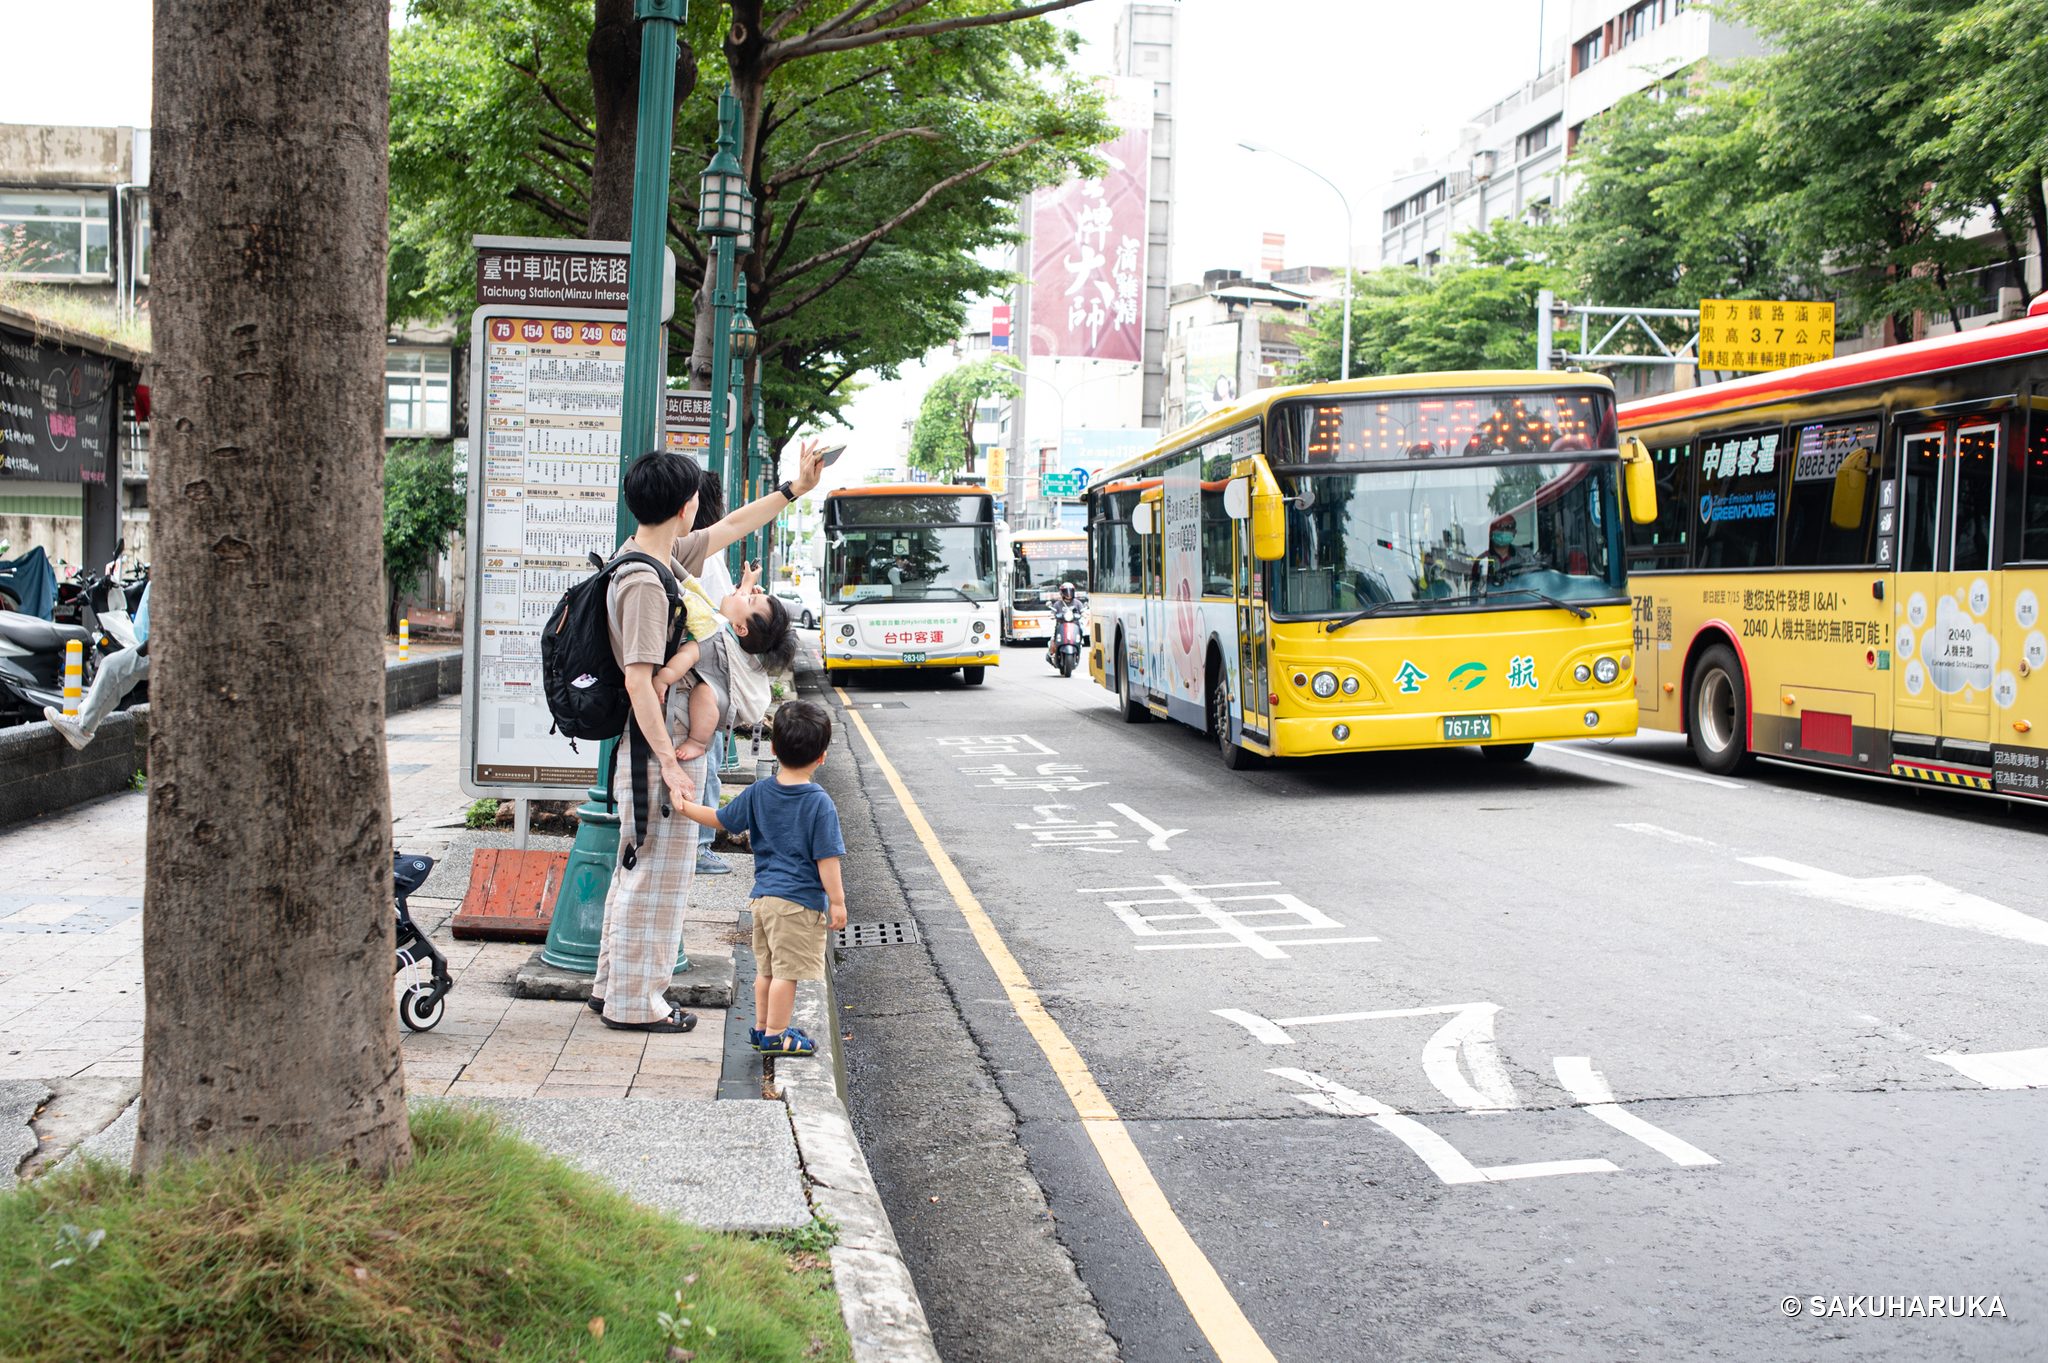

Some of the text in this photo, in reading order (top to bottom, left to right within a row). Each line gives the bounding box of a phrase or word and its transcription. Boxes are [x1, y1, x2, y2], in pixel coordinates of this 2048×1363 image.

[483, 255, 627, 285] 臺中車站(民族路
[483, 286, 526, 300] Taichung
[1702, 304, 1832, 322] 前方鐵路涵洞
[497, 324, 510, 337] 75
[523, 325, 543, 338] 154
[552, 326, 573, 339] 158
[582, 327, 602, 340] 249
[496, 347, 508, 355] 75
[493, 417, 509, 426] 154
[1702, 434, 1779, 480] 中鹿客運
[491, 488, 506, 497] 158
[487, 558, 503, 567] 249
[1703, 590, 1726, 604] 即日起至
[1727, 591, 1740, 604] 7/15
[1743, 590, 1810, 612] 邀您投件發想
[1743, 618, 1768, 637] 2040
[884, 630, 944, 644] 台中客運
[1948, 629, 1971, 641] 2040
[1944, 645, 1973, 658] 人機共融
[1445, 719, 1490, 737] 767-FX
